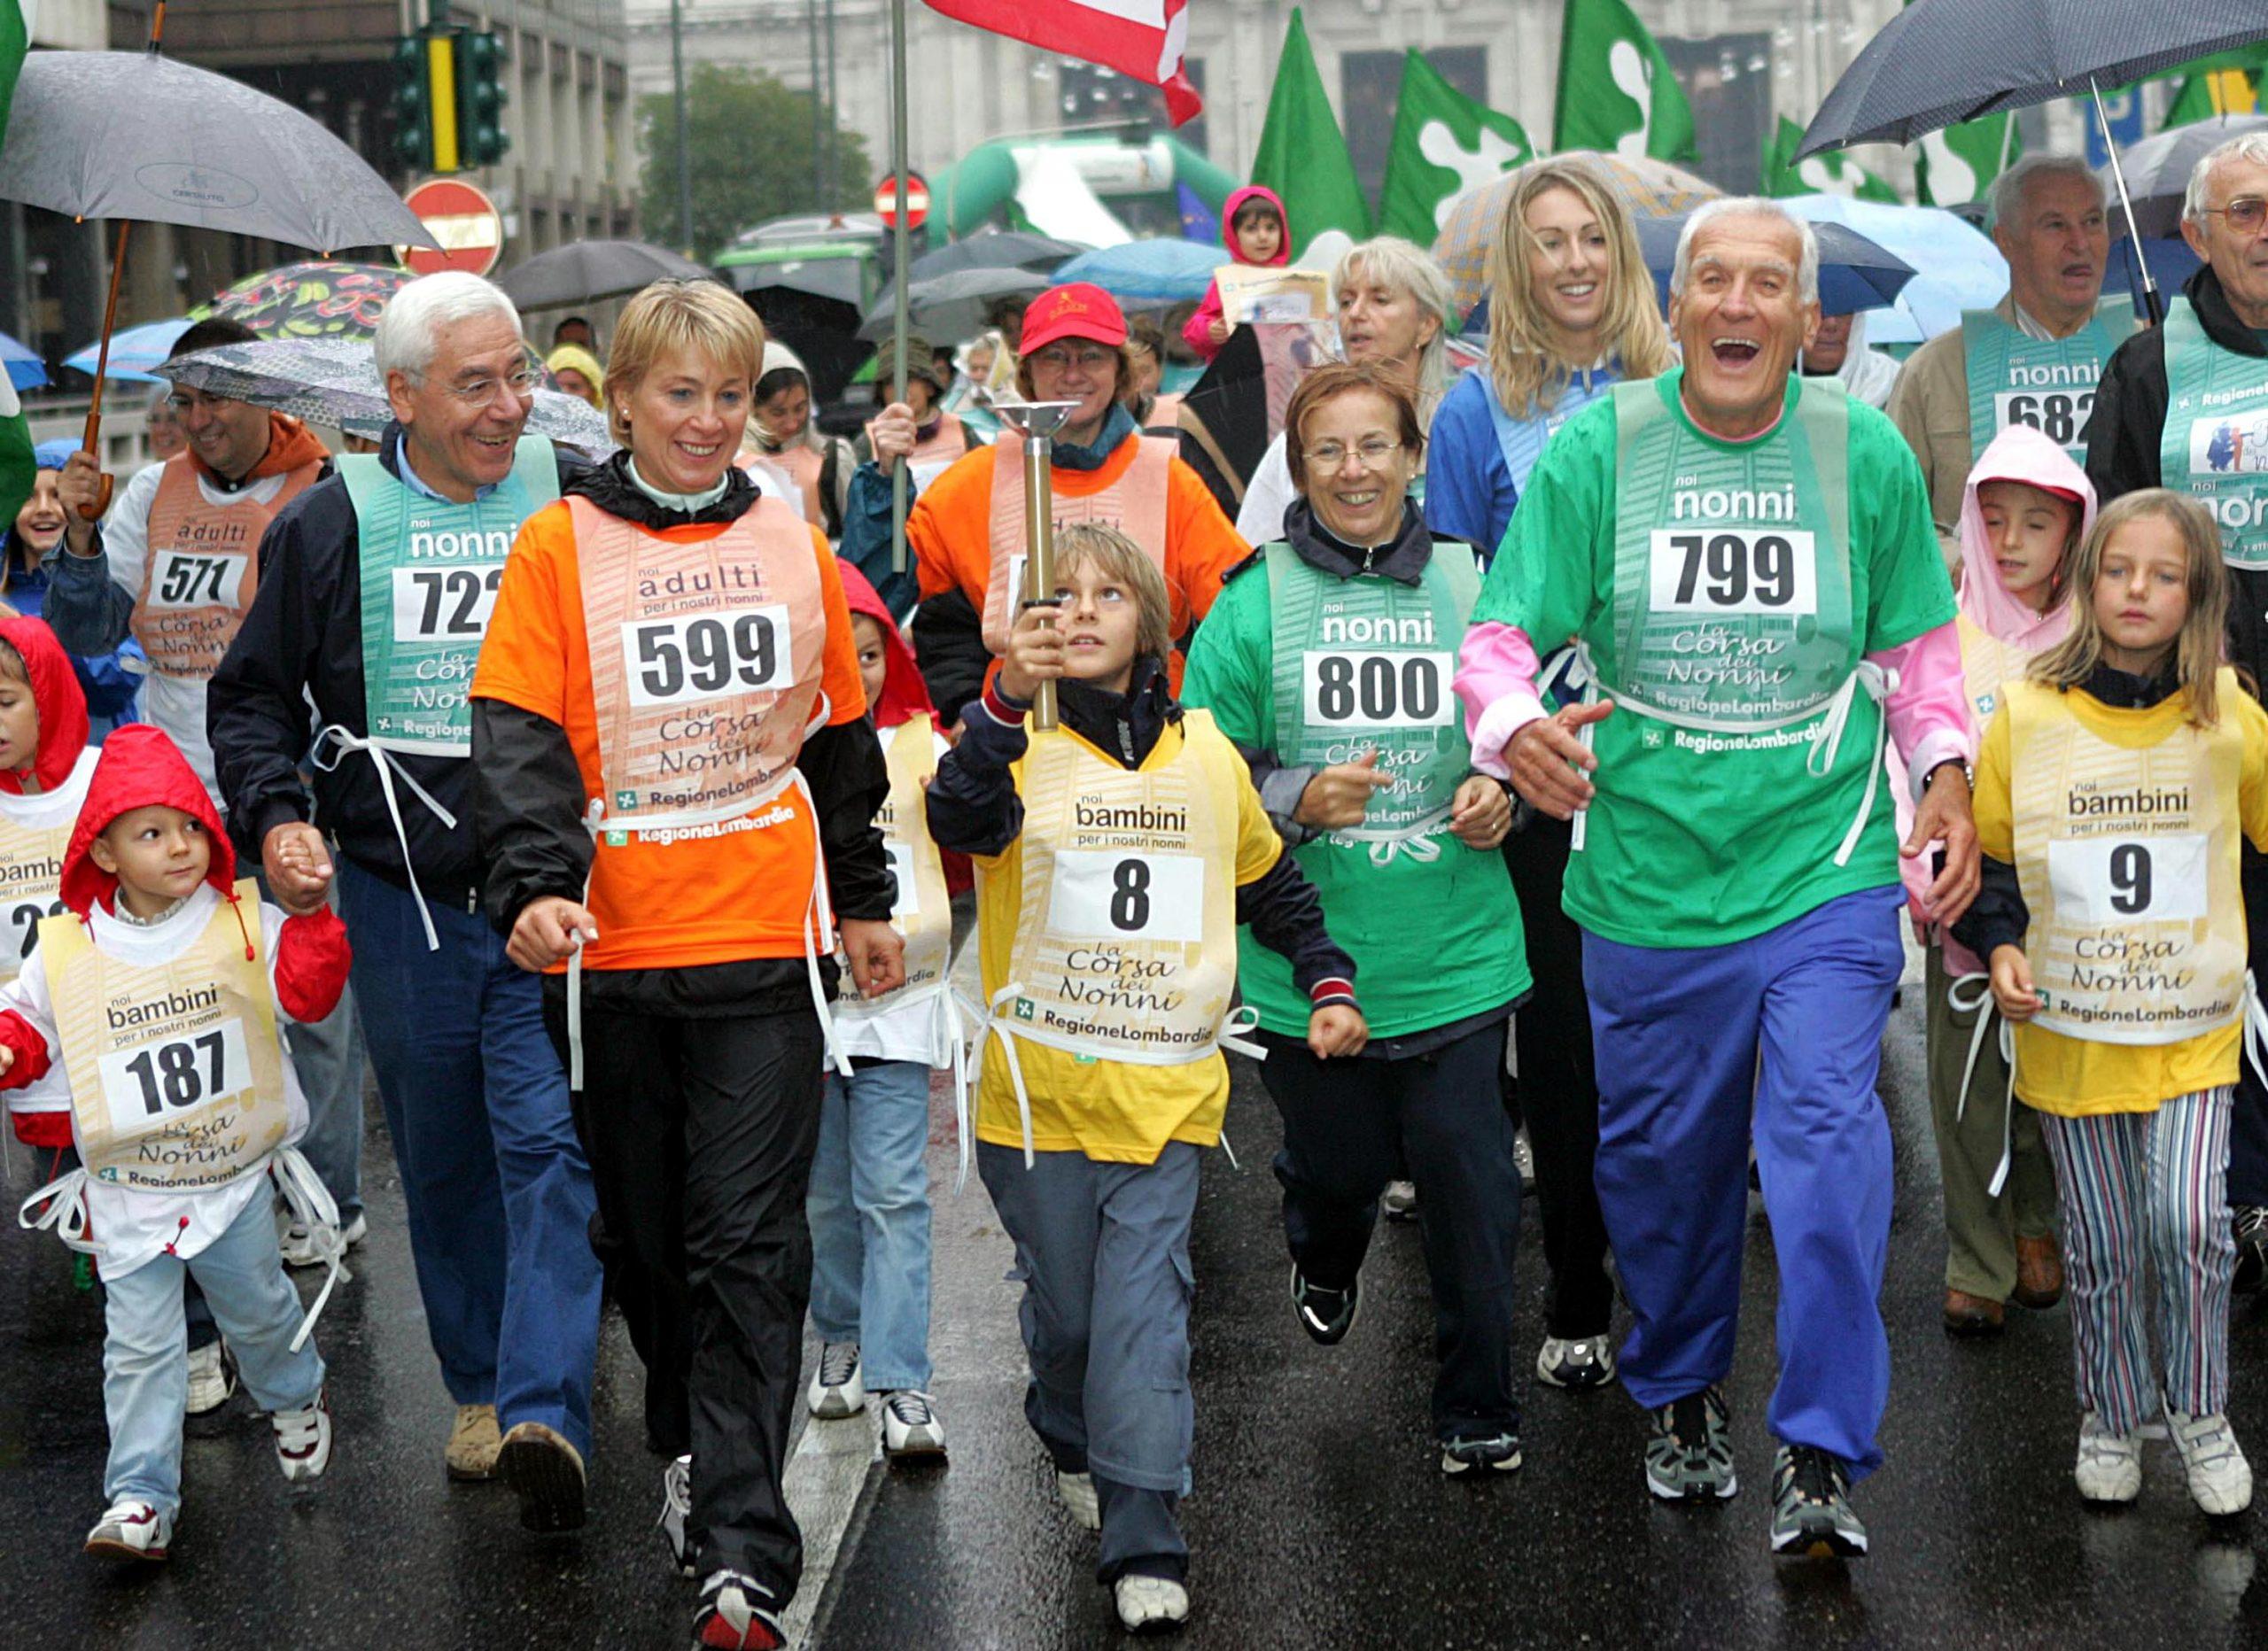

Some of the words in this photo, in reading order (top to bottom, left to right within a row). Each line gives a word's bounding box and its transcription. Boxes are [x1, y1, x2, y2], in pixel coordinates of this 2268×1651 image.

[2009, 358, 2101, 385] nonni
[1675, 475, 1697, 486] noi
[1674, 484, 1794, 521] nonni
[177, 524, 247, 541] adulti
[411, 518, 430, 528] noi
[161, 556, 229, 603] 571
[638, 567, 660, 577] noi
[639, 564, 761, 597] adulti
[1670, 535, 1794, 606] 799
[643, 601, 666, 616] per
[680, 595, 721, 610] nostri
[726, 592, 764, 606] nonni
[1324, 602, 1343, 613] noi
[1323, 611, 1433, 644] nonni
[1699, 623, 1729, 637] La
[441, 651, 467, 663] La
[637, 614, 777, 697] 599
[1673, 632, 1785, 656] Corsa
[1667, 659, 1793, 686] Nonni
[1317, 656, 1440, 720] 800
[659, 712, 768, 742] Corsa
[686, 707, 716, 720] La
[1349, 736, 1376, 749] La
[659, 740, 770, 776] Nonni
[1082, 794, 1102, 804] noi
[2075, 783, 2096, 792] noi
[2069, 787, 2187, 816] bambini
[1076, 802, 1186, 832] bambini
[2071, 823, 2093, 835] per
[2106, 820, 2148, 831] nostri
[2152, 820, 2189, 831] nonni
[1078, 834, 1099, 847] per
[1112, 835, 1149, 847] nostri
[1152, 839, 1186, 849] nonni
[2109, 843, 2152, 915] 9
[1110, 858, 1150, 931] 8
[2101, 928, 2125, 941] La
[1096, 942, 1122, 956] La
[2076, 936, 2186, 962] Corsa
[1067, 949, 1176, 978] Corsa
[2120, 959, 2161, 974] dei
[1111, 977, 1149, 991] dei
[2071, 964, 2195, 992] Nonni
[106, 982, 218, 1029] bambini
[112, 994, 131, 1008] noi
[1059, 976, 1182, 1012] Nonni
[2060, 999, 2232, 1023] RegioneLombardia
[114, 1033, 136, 1048] per
[148, 1021, 185, 1039] nostri
[189, 1011, 221, 1027] nonni
[1045, 1010, 1213, 1043] RegioneLombardia
[125, 1030, 224, 1115] 187
[138, 1136, 246, 1165] Nonni
